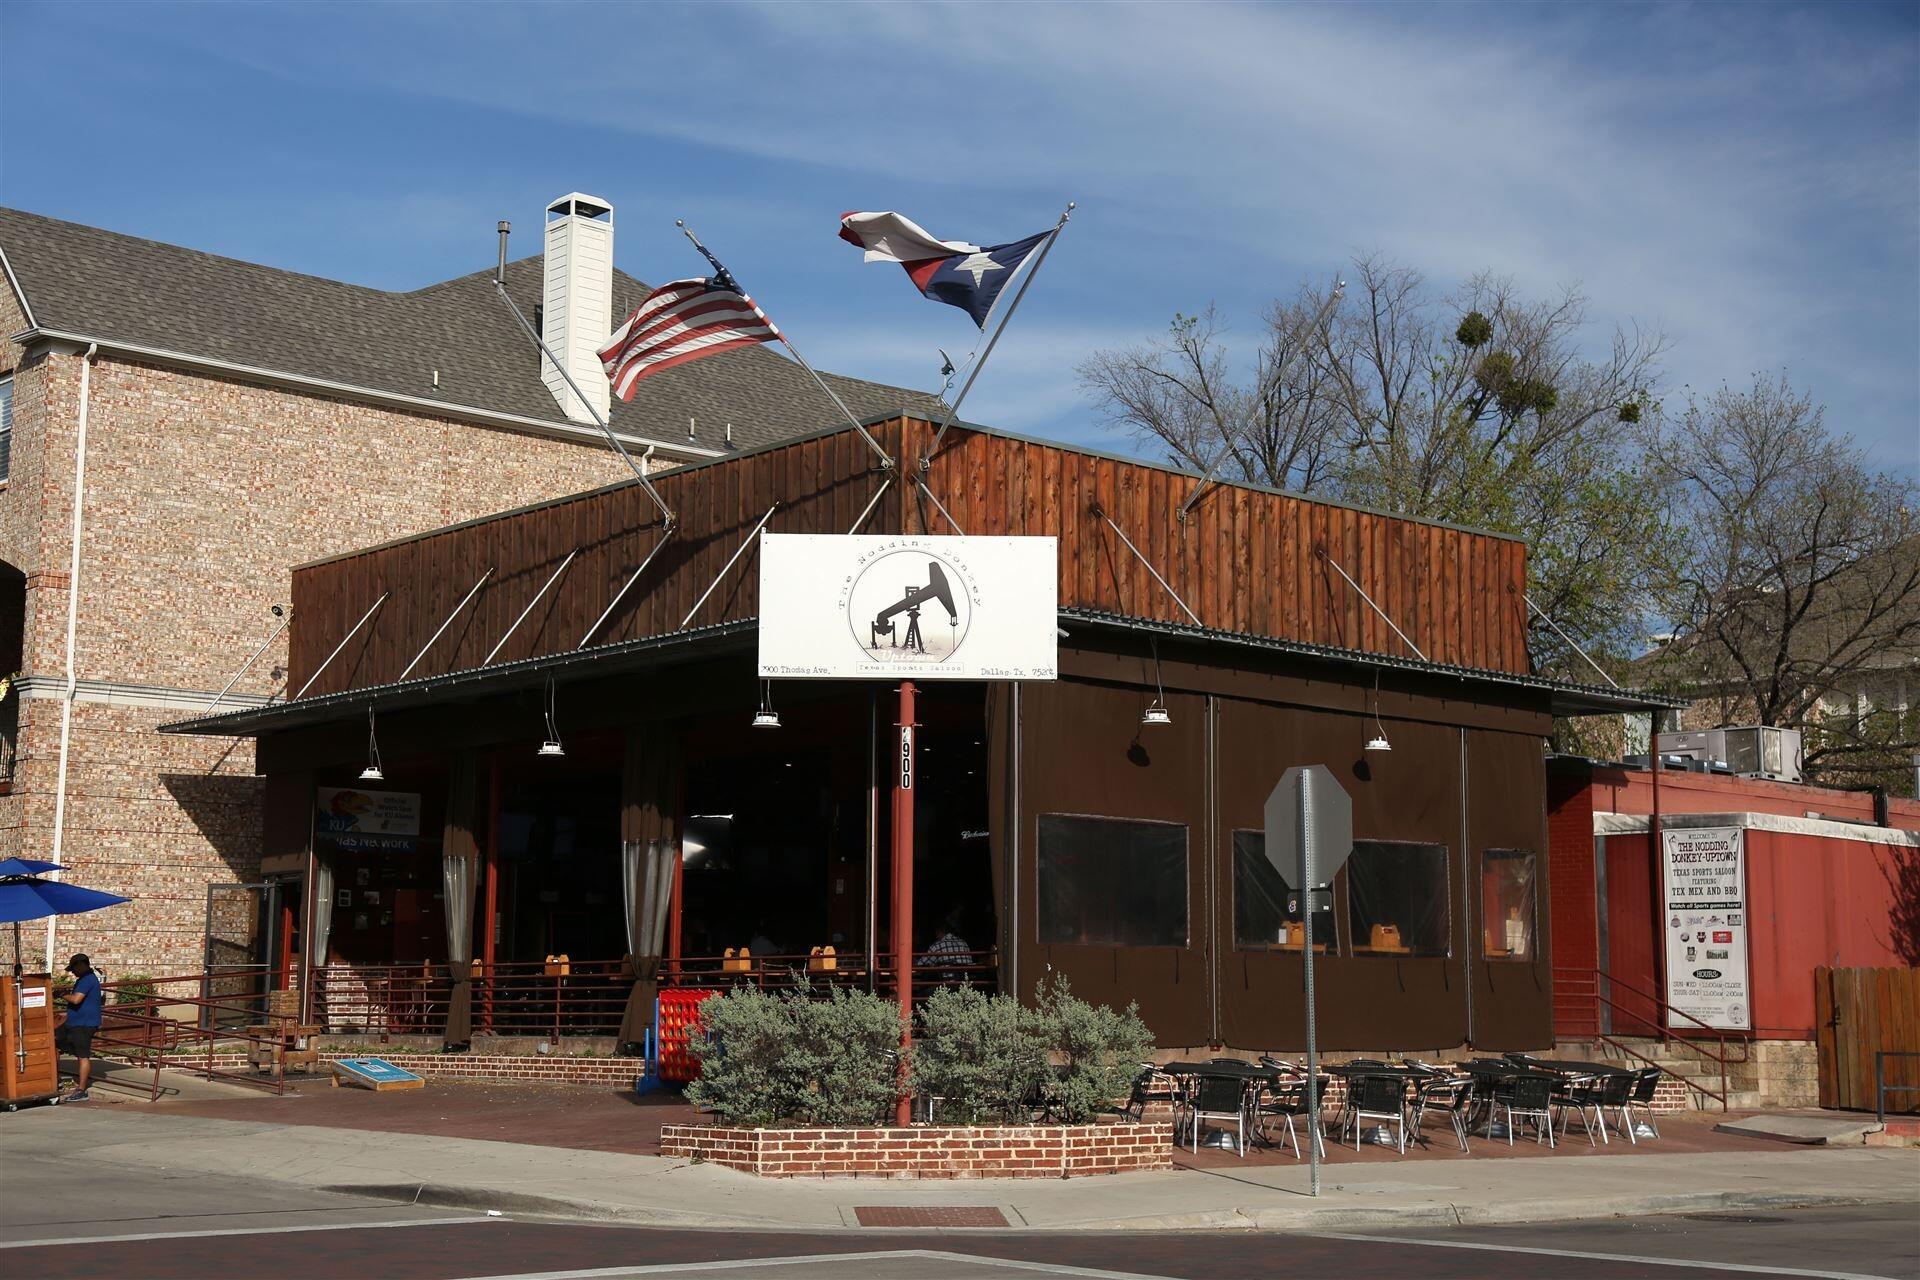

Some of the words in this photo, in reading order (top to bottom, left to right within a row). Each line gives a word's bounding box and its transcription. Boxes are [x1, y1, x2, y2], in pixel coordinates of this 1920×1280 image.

[880, 649, 935, 663] Uptown
[1678, 842, 1693, 852] THE
[1695, 841, 1729, 851] NODDING
[1671, 852, 1736, 863] DONKEY-UPTOWN
[1673, 869, 1690, 877] TEXAS
[1692, 868, 1712, 876] SPORTS
[1715, 867, 1736, 876] SALOON
[1672, 887, 1685, 896] TEX
[1688, 887, 1703, 896] MEX
[1707, 887, 1721, 895] AND
[1724, 886, 1738, 896] BBQ
